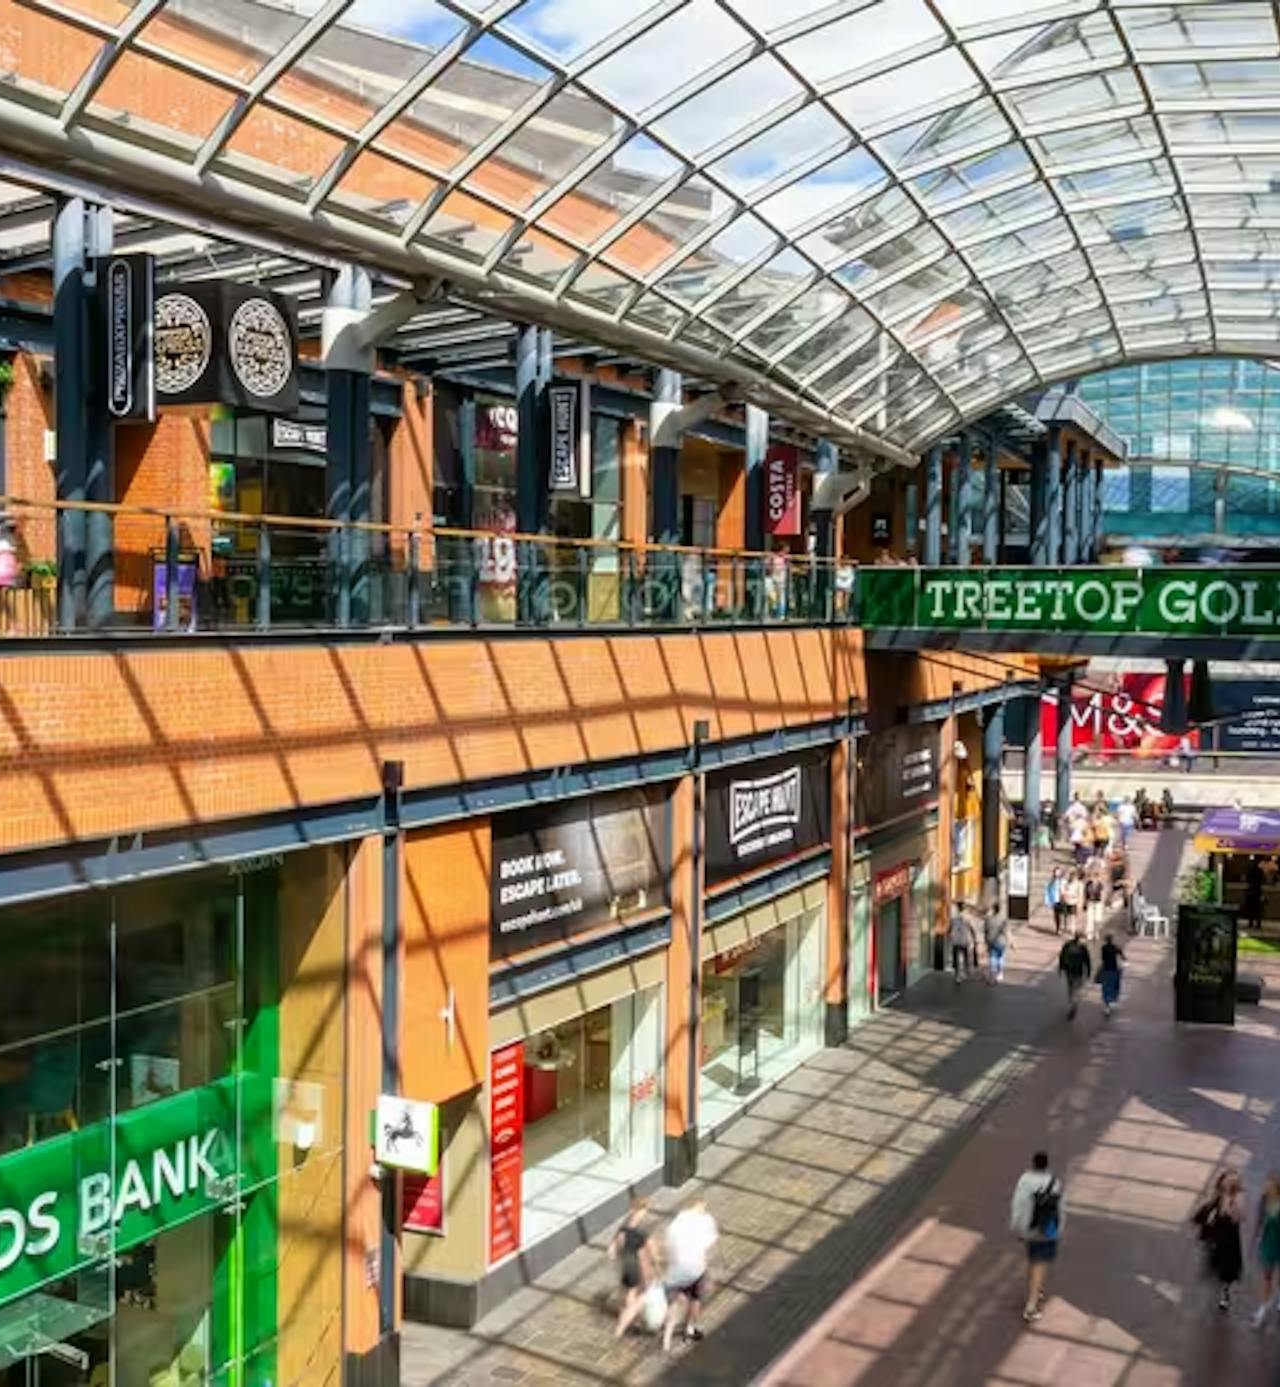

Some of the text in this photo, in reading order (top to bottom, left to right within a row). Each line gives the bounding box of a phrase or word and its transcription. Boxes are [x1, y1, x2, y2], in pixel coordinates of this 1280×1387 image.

[768, 460, 785, 521] COSTA
[926, 578, 1145, 622] TREETOP
[499, 855, 535, 879] BOOK
[499, 876, 546, 905] ESCAPE
[79, 1127, 221, 1234] BANK
